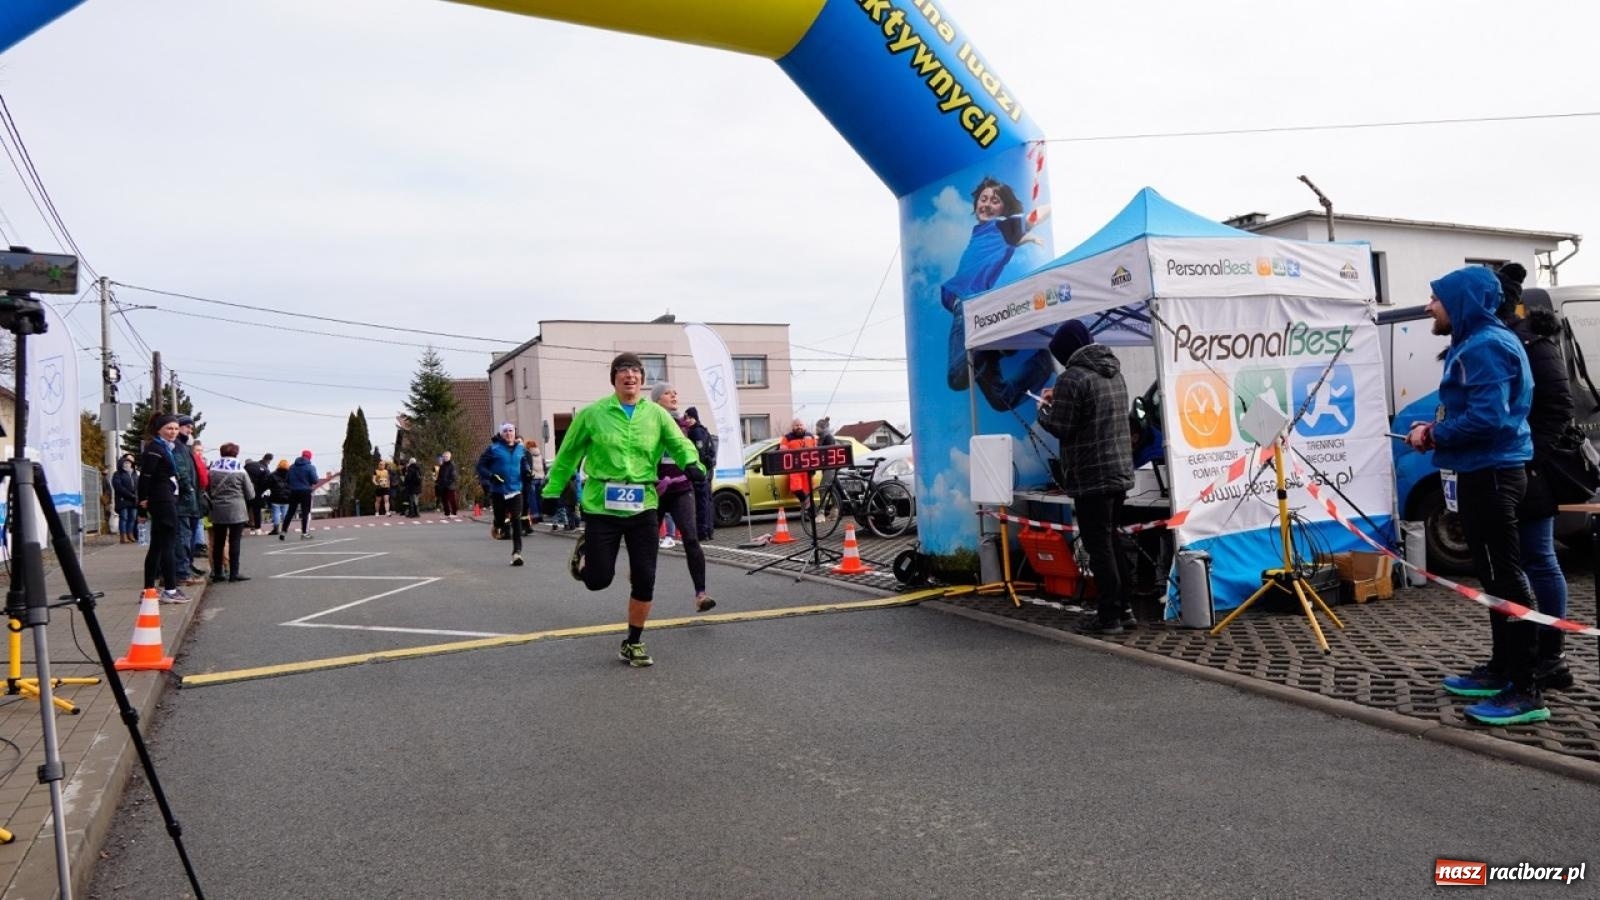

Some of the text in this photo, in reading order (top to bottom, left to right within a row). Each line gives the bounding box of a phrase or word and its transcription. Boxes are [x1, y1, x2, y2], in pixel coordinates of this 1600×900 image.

[858, 0, 1000, 147] ktywnych
[957, 42, 1022, 122] ludzi
[1167, 258, 1252, 276] PersonalBest
[974, 300, 1030, 329] PersonalBest
[1174, 321, 1354, 362] PersonalBest
[783, 448, 846, 470] 0:55:35
[617, 488, 636, 502] 26
